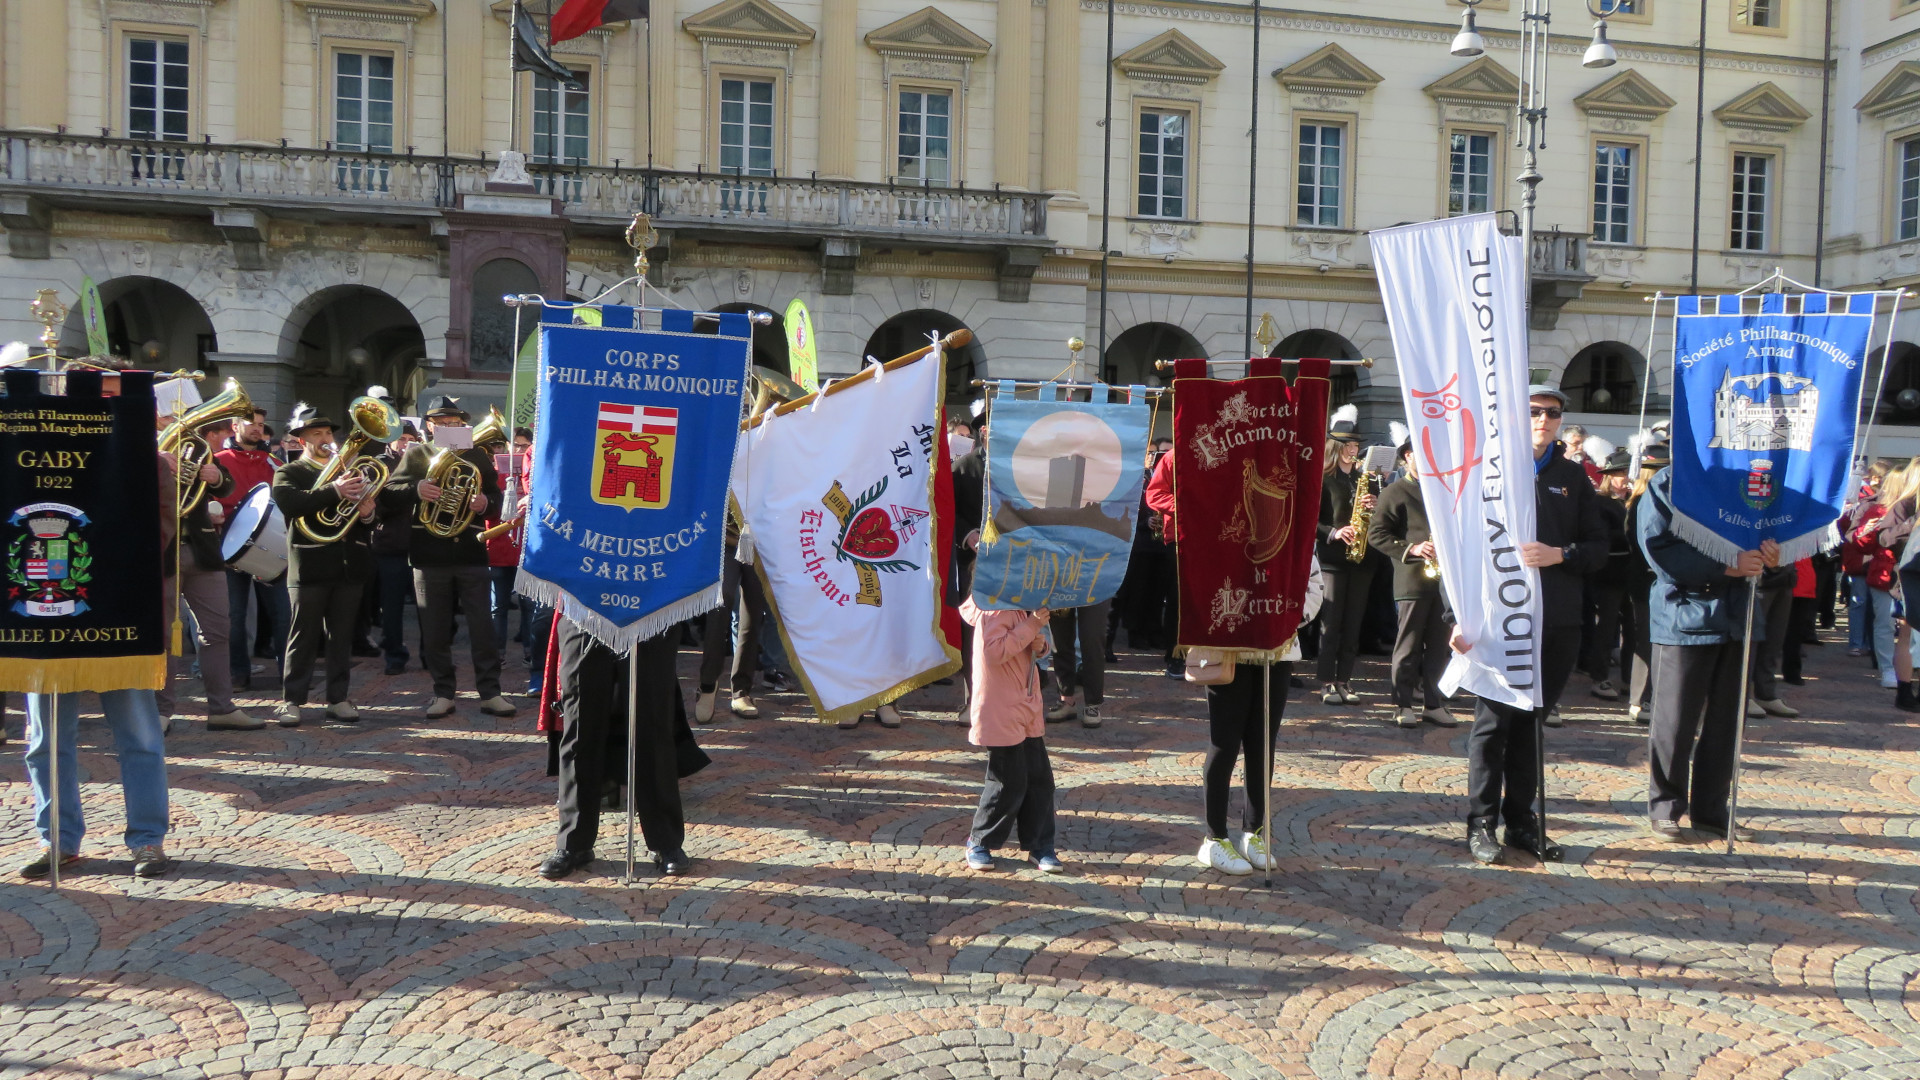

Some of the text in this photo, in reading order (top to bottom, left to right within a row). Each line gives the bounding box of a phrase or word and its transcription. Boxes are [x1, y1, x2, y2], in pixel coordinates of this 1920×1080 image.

[1680, 325, 1857, 370] Société Philharmonique
[1745, 345, 1795, 359] Arnad
[605, 348, 681, 371] CORPS
[544, 365, 739, 397] PHILHARMONIQUE
[39, 409, 115, 421] Filarmonic
[0, 422, 38, 435] Regina
[17, 450, 92, 469] GABY
[889, 440, 914, 480] La
[35, 475, 73, 489] 1922
[828, 492, 845, 514] 1906
[1718, 508, 1793, 530] Vallée d'Aoste
[579, 511, 708, 558] MEUSECCA"
[580, 556, 667, 582] SARRE
[799, 509, 850, 607] Eischeme
[863, 571, 875, 595] 2006
[600, 592, 641, 610] 2002
[1051, 592, 1078, 602] 2002
[0, 626, 139, 643] LLEE D'AOSTE
